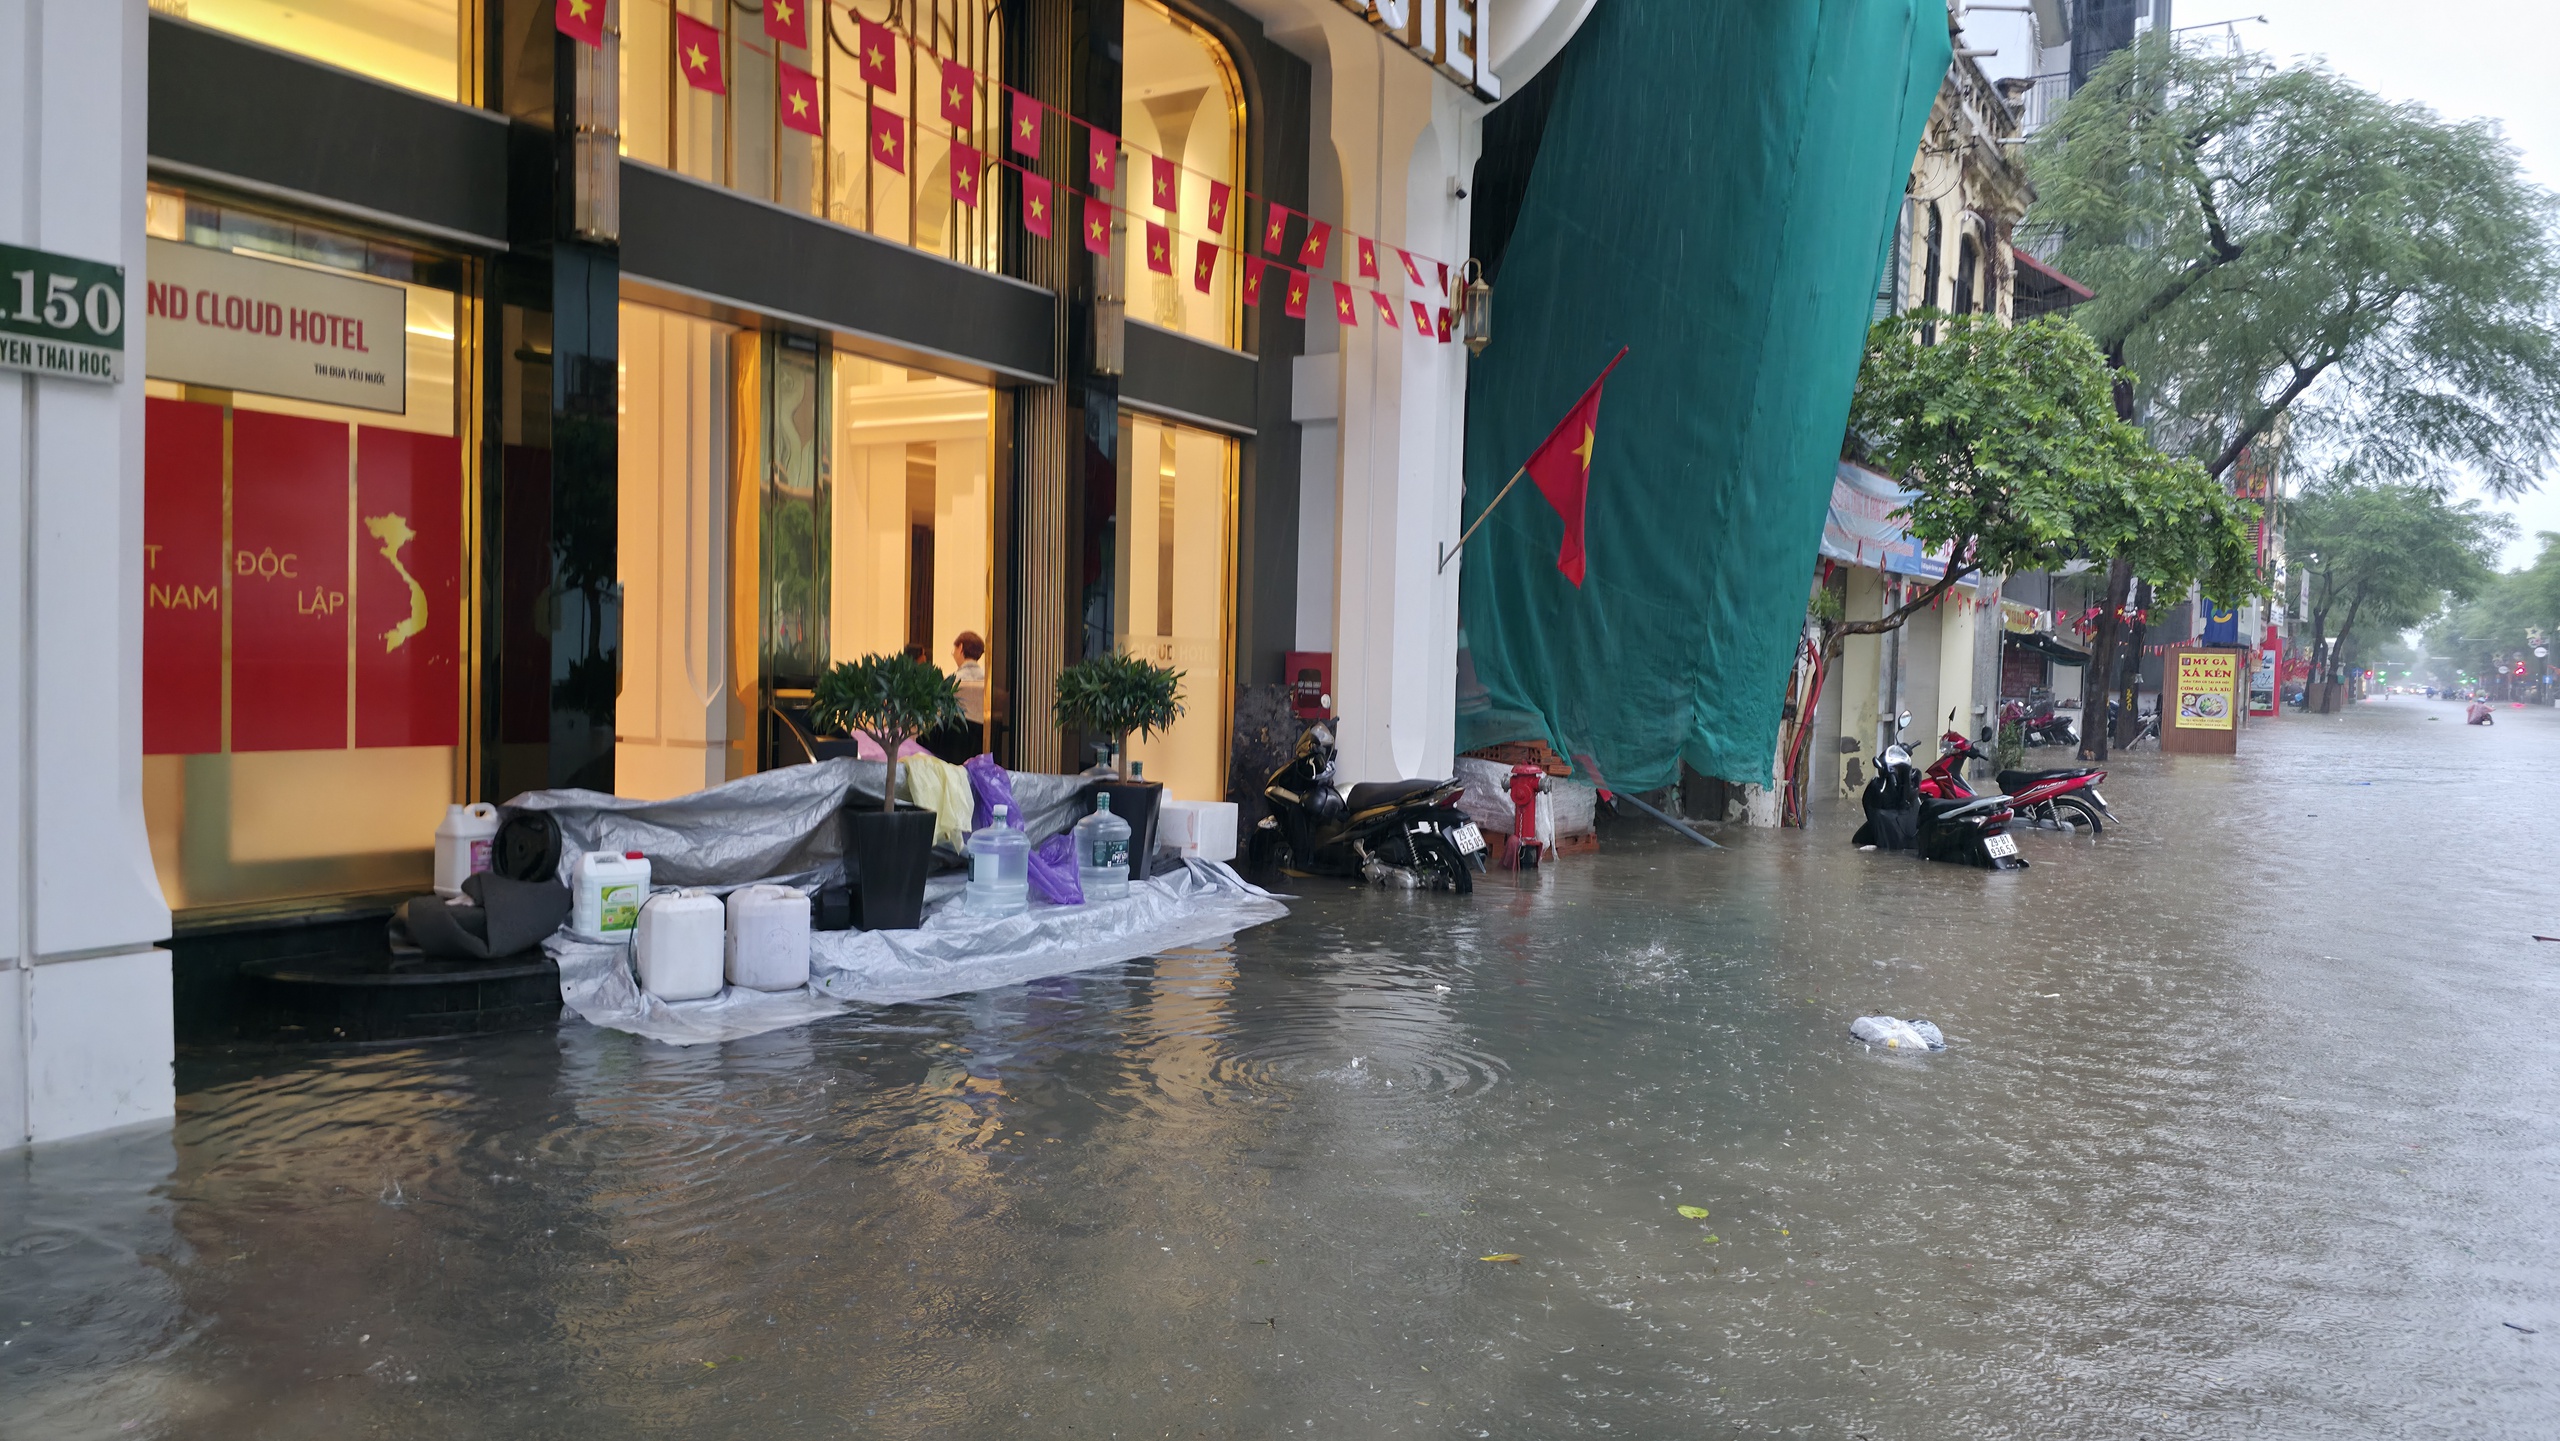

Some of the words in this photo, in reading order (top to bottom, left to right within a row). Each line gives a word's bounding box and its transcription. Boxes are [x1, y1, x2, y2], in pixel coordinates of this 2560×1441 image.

[195, 289, 283, 337] CLOUD
[290, 307, 369, 353] HOTEL
[37, 343, 74, 372] THAI
[314, 363, 328, 376] THI
[235, 546, 298, 582] ĐỘC
[150, 583, 218, 611] NAM
[298, 585, 345, 620] LẬP
